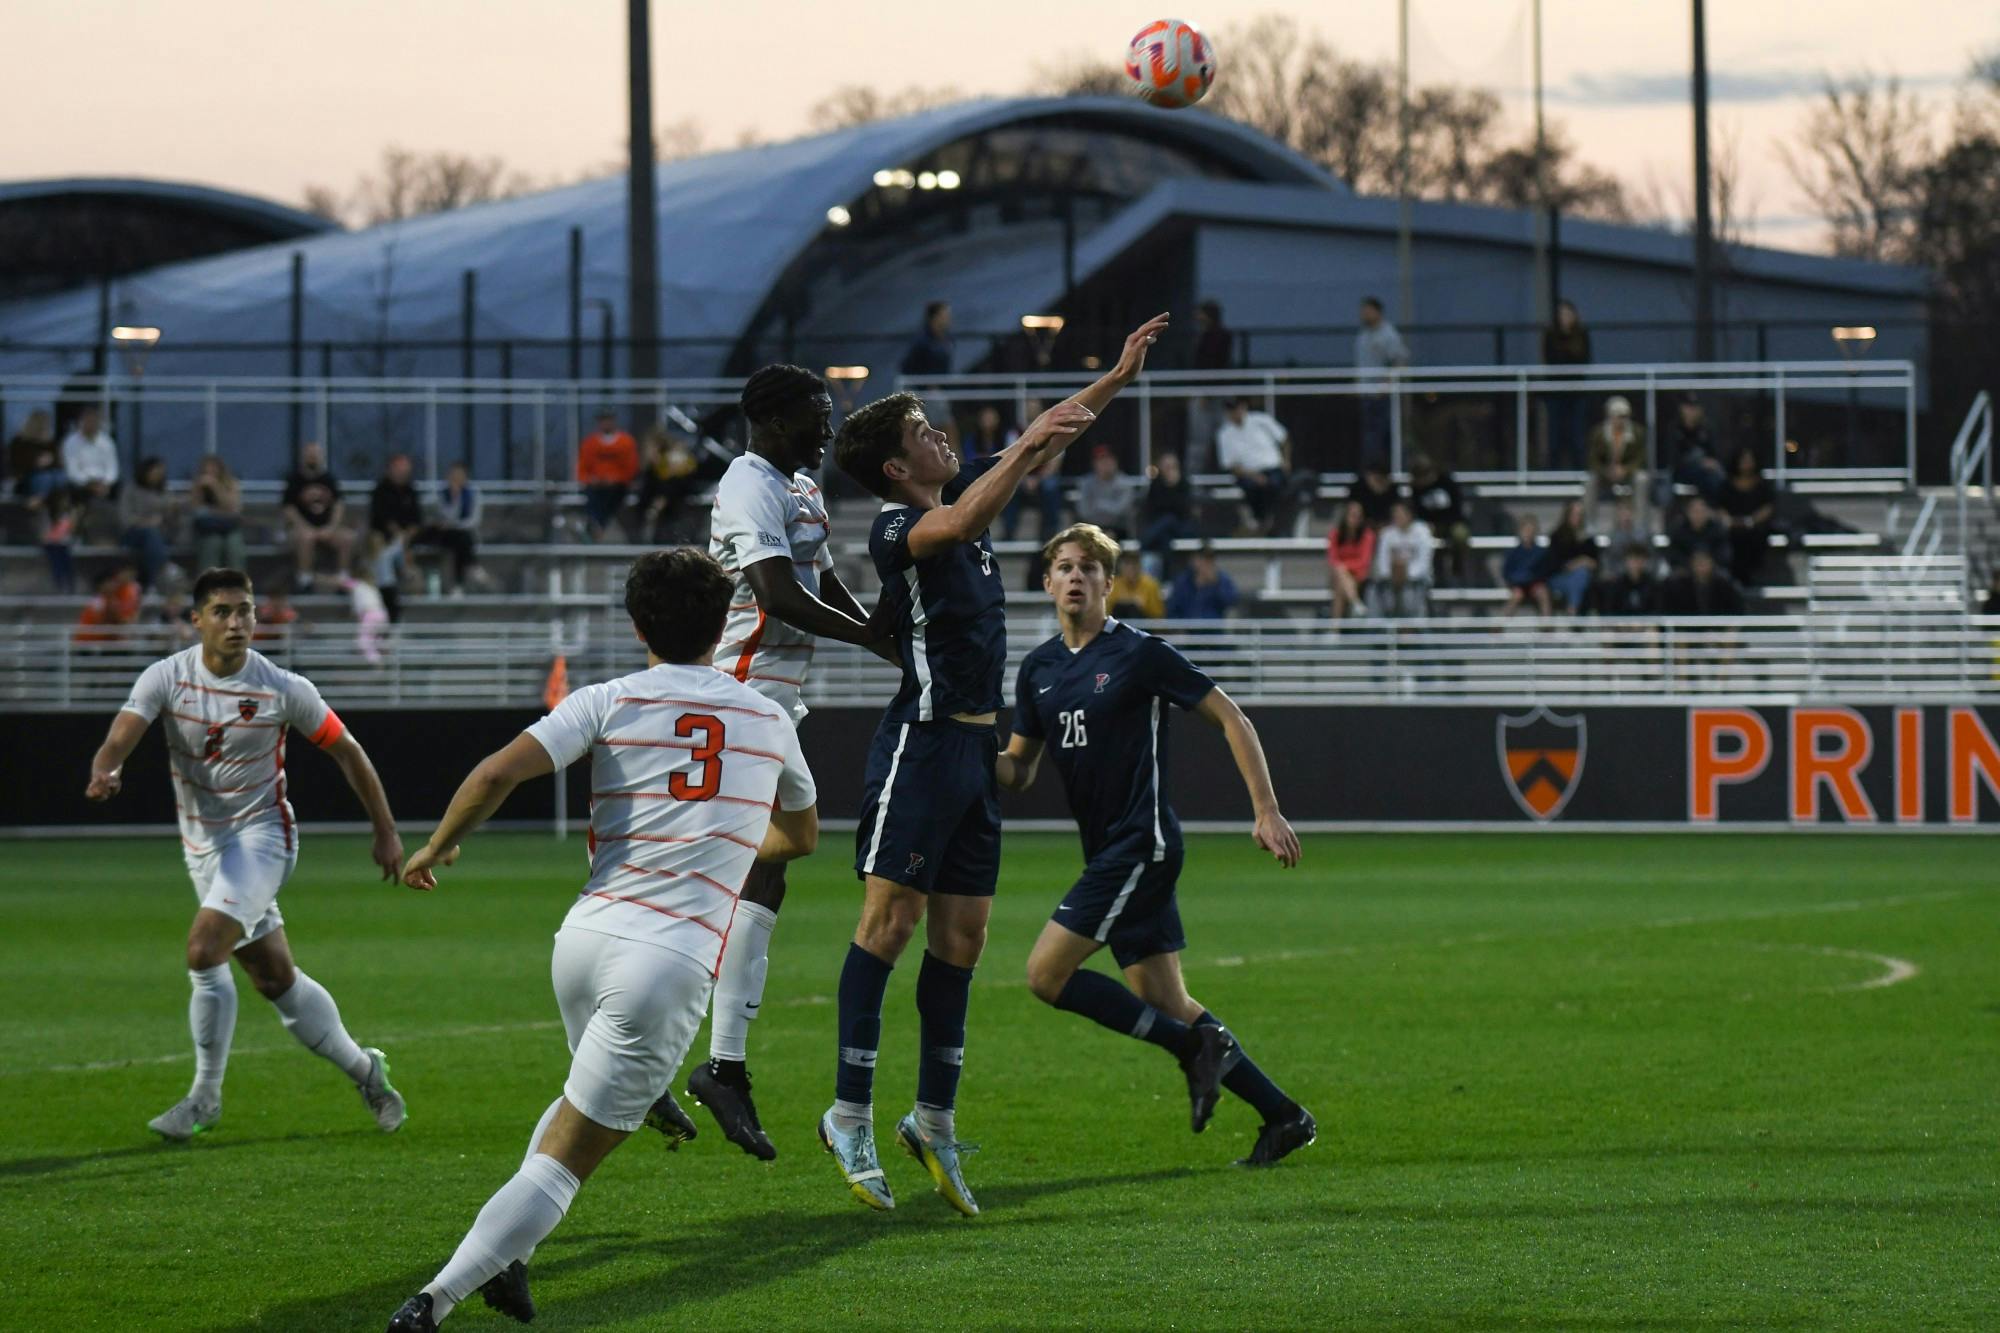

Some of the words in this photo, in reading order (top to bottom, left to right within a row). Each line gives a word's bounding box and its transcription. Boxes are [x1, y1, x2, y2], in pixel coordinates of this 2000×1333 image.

[1094, 673, 1111, 694] P
[204, 726, 224, 766] 2
[1058, 709, 1088, 749] 26
[668, 713, 725, 801] 3
[906, 853, 925, 875] P
